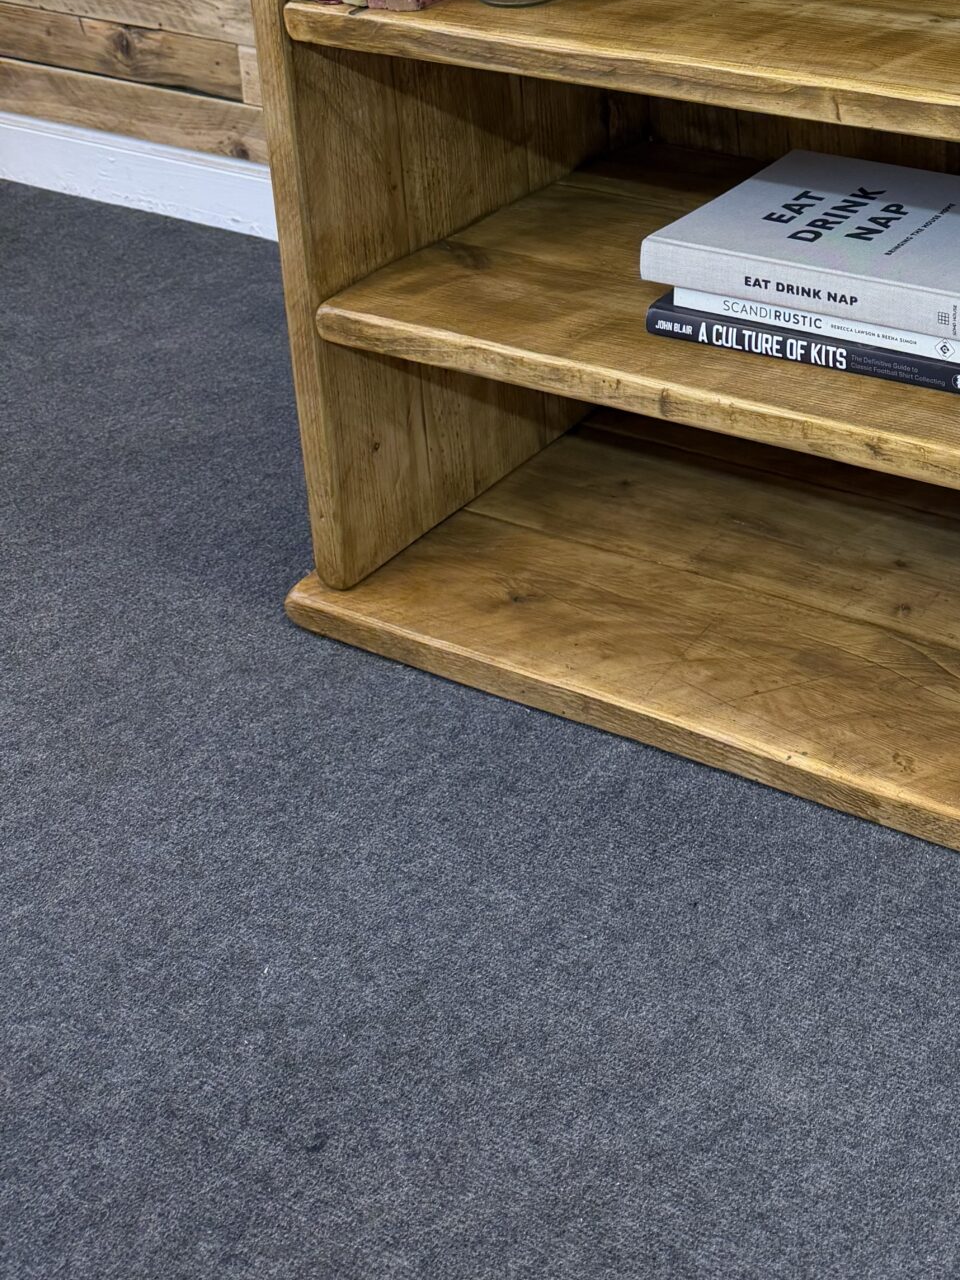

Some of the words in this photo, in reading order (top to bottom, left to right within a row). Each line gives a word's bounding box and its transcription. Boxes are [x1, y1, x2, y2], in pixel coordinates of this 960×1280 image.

[761, 190, 825, 224] EAT
[787, 187, 887, 243] DRINK
[844, 203, 909, 241] NAP
[884, 236, 913, 255] BRINGING
[910, 228, 925, 236] THE
[921, 214, 942, 228] HOUSE
[744, 276, 771, 290] EAT
[775, 282, 822, 300] DRINK
[827, 291, 858, 306] NAP
[655, 320, 673, 332] JOHN
[673, 322, 692, 335] BLAIR
[830, 324, 854, 333] REBECCA
[854, 328, 876, 337] LAWSON
[698, 322, 708, 343] A
[712, 324, 783, 358] CULTURE
[786, 338, 807, 361] OF
[810, 342, 847, 370] KITS
[850, 355, 862, 363] The
[863, 356, 891, 368] Definitive
[892, 362, 910, 372] Guide
[850, 362, 872, 372] Classic
[873, 365, 898, 377] Football
[898, 370, 914, 380] Shirt
[914, 374, 945, 387] Collecting
